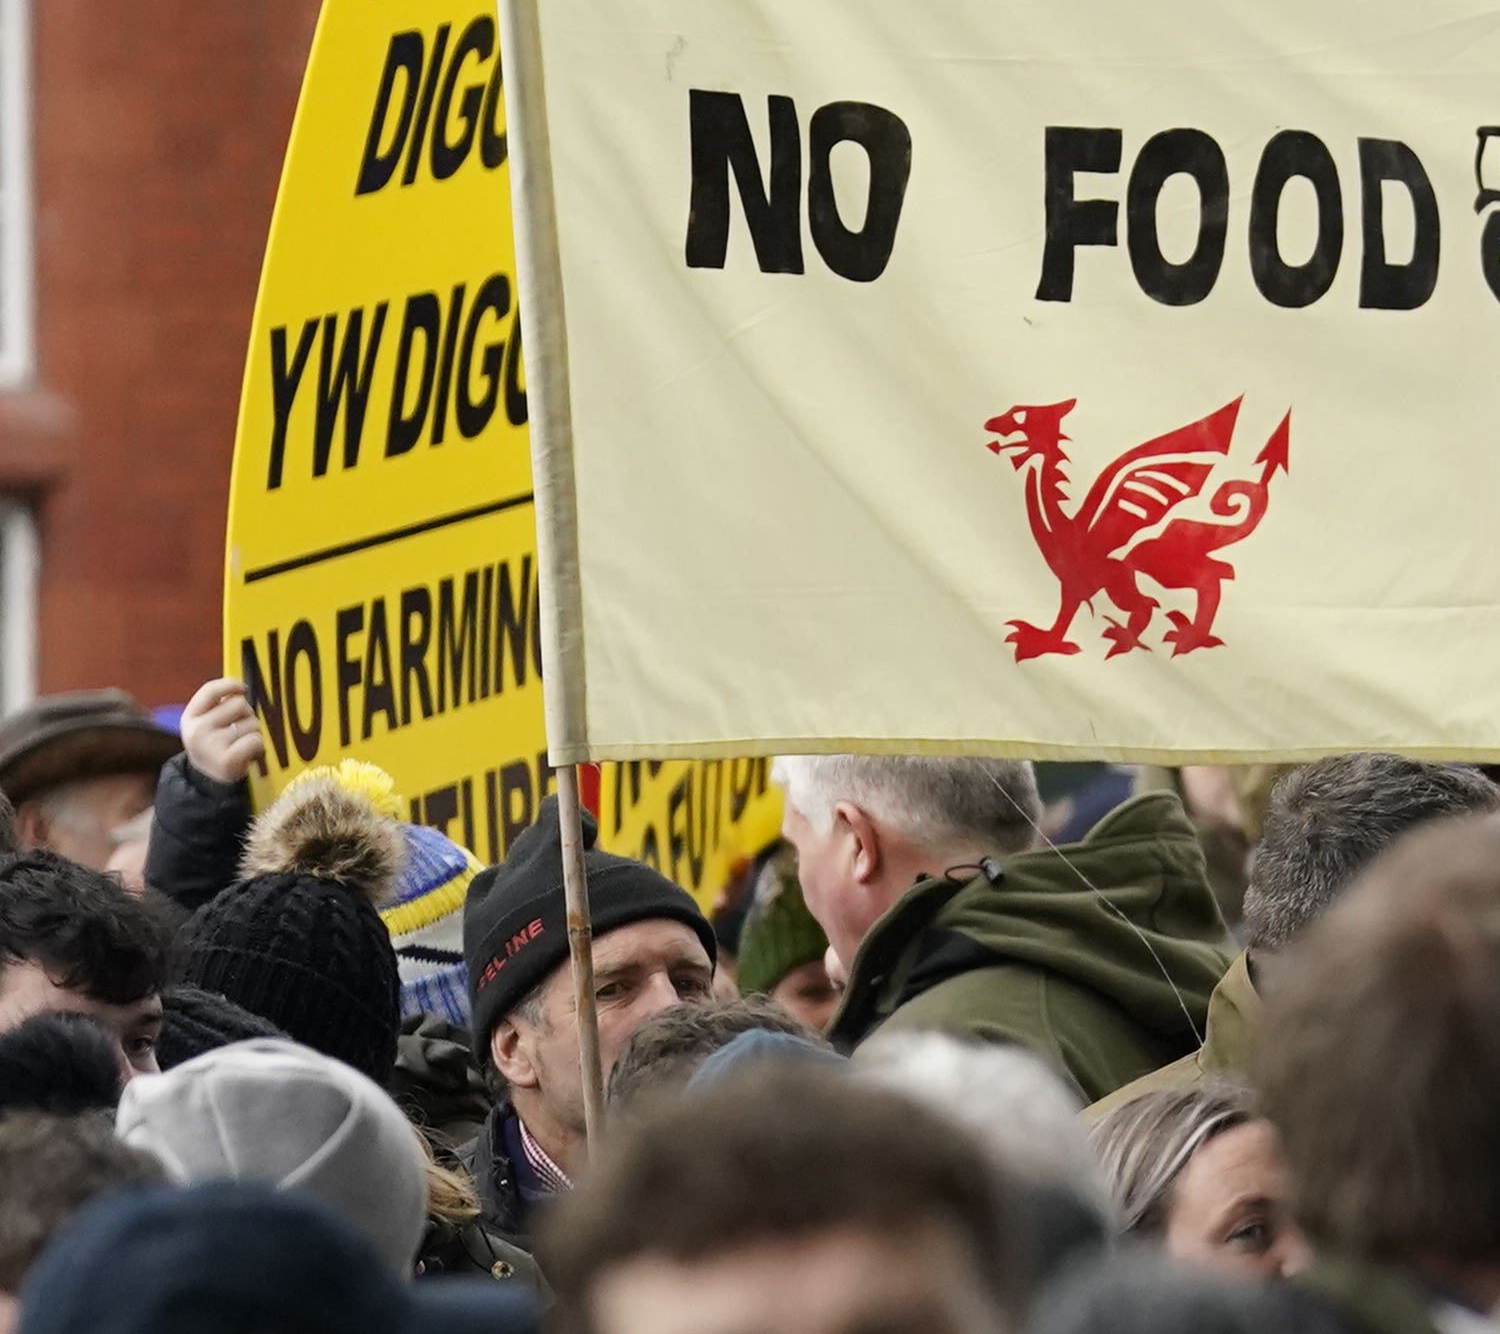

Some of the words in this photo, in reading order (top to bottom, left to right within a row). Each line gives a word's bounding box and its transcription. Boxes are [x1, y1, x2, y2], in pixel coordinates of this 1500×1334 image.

[685, 88, 912, 283] NO
[1035, 126, 1441, 311] FOOD
[266, 300, 390, 491] YW
[240, 620, 323, 777] NO
[336, 552, 541, 747] FARMIN
